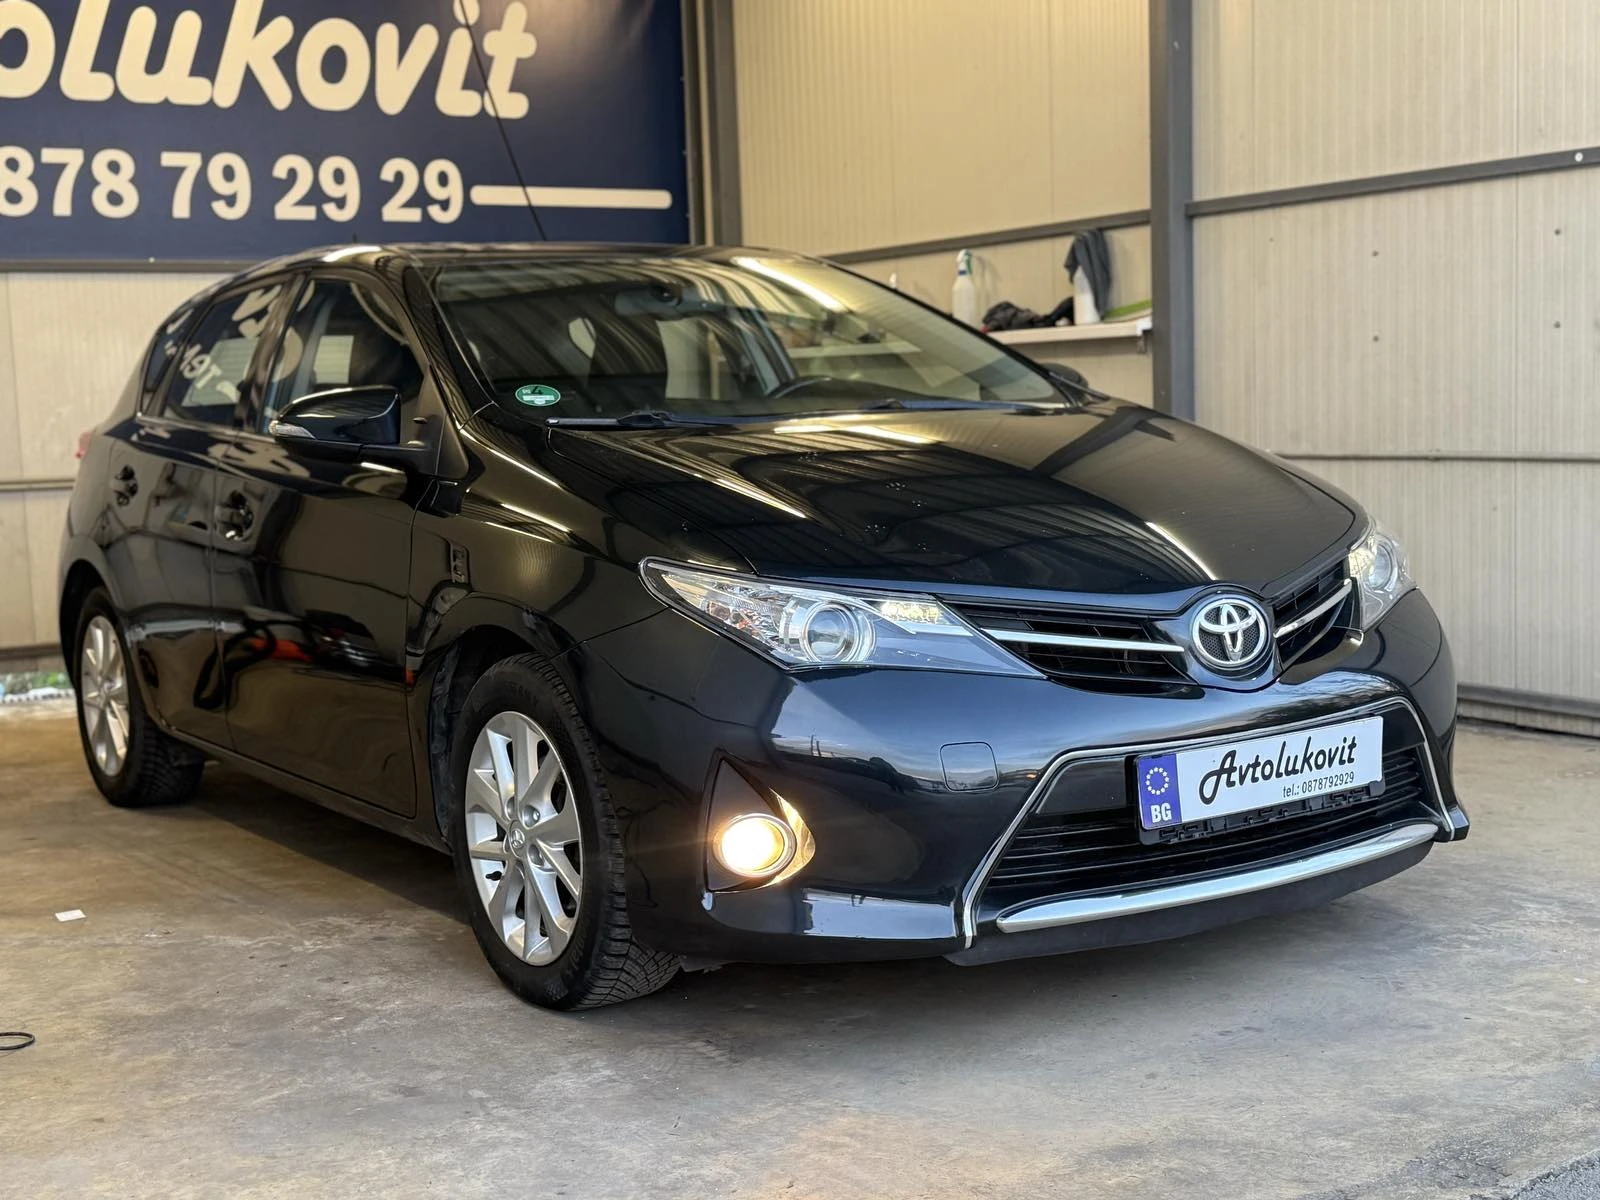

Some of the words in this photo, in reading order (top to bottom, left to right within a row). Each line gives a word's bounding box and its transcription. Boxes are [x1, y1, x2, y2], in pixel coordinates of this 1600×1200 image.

[0, 0, 537, 119] olukovit
[0, 146, 139, 218] 878
[160, 151, 252, 221] 79
[272, 155, 361, 223] 29
[379, 158, 464, 224] 29
[1199, 736, 1357, 805] Avtolukovit
[1283, 785, 1300, 799] tel.:
[1302, 772, 1355, 795] 0878792929
[1150, 803, 1172, 823] BG
